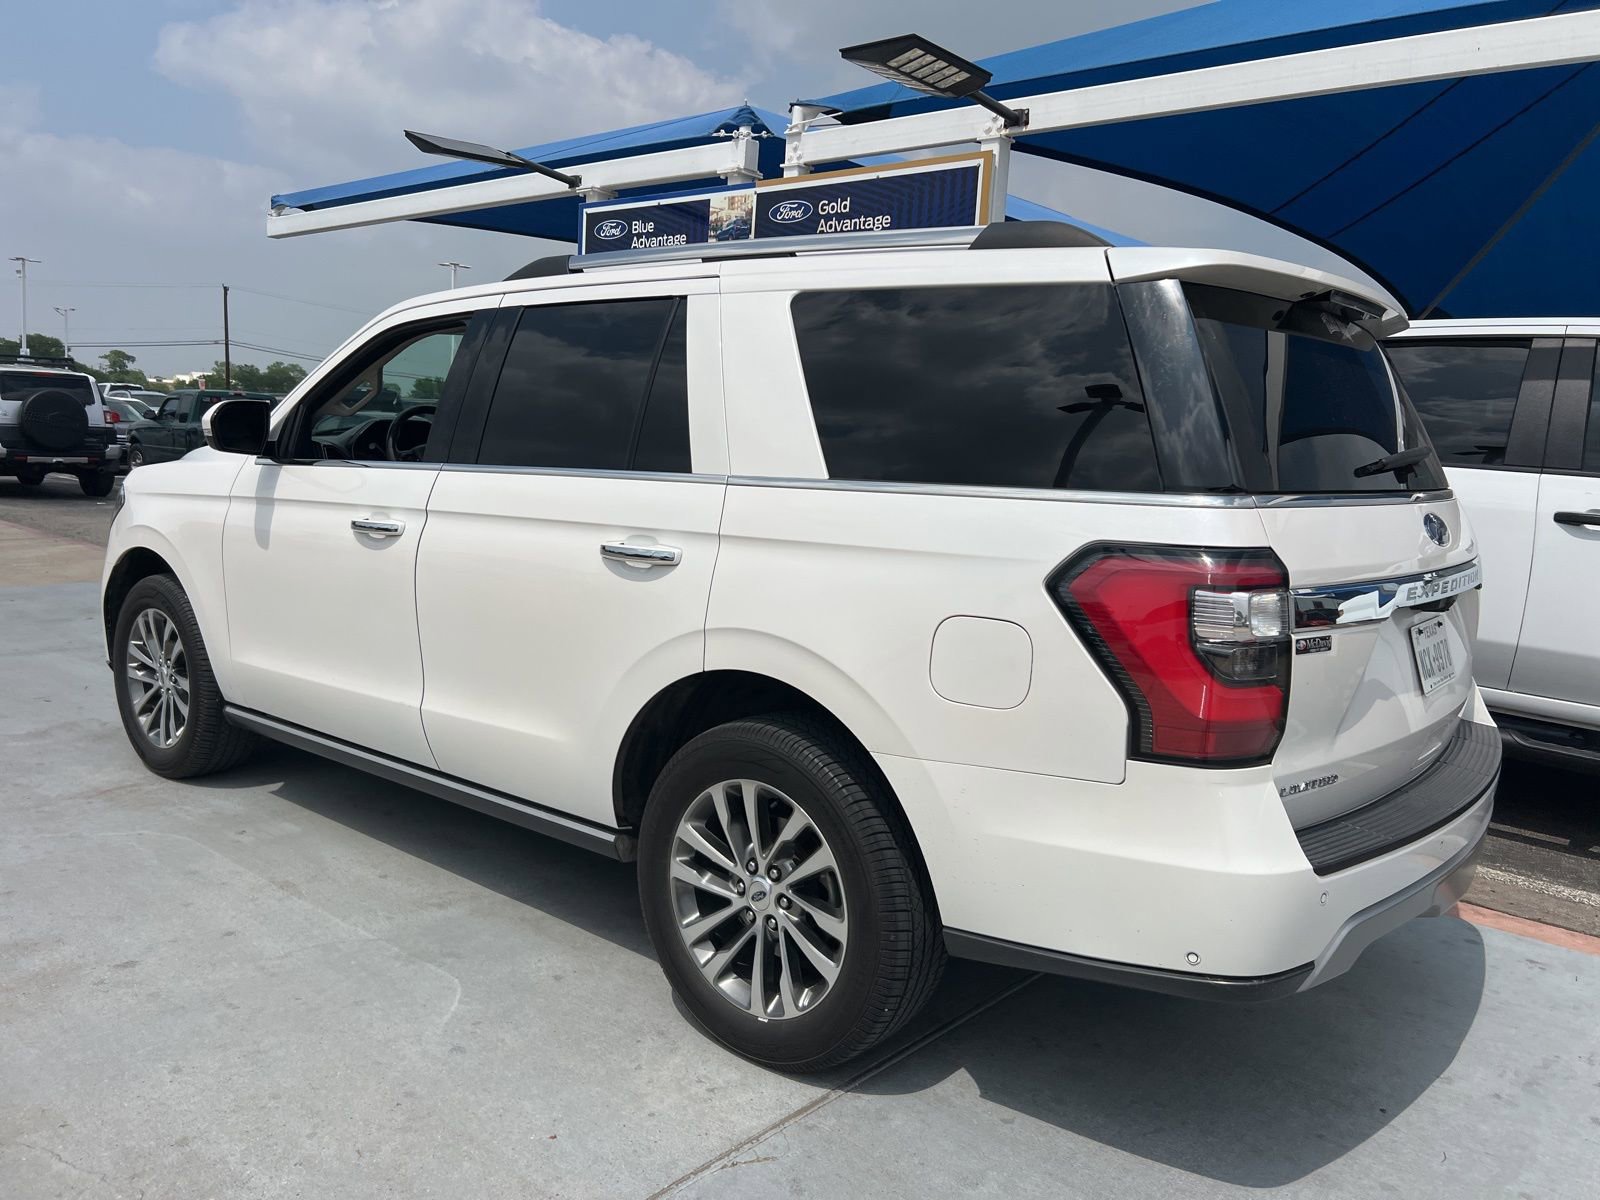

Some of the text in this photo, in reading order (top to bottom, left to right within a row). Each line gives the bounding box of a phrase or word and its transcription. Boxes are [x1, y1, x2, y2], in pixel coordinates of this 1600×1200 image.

[777, 203, 804, 219] Ford
[818, 197, 850, 215] Gold
[601, 222, 622, 236] Ford
[632, 220, 654, 234] Blue
[817, 215, 891, 234] Advantage
[631, 234, 687, 249] Advantage
[1406, 567, 1479, 601] EXPEDITION
